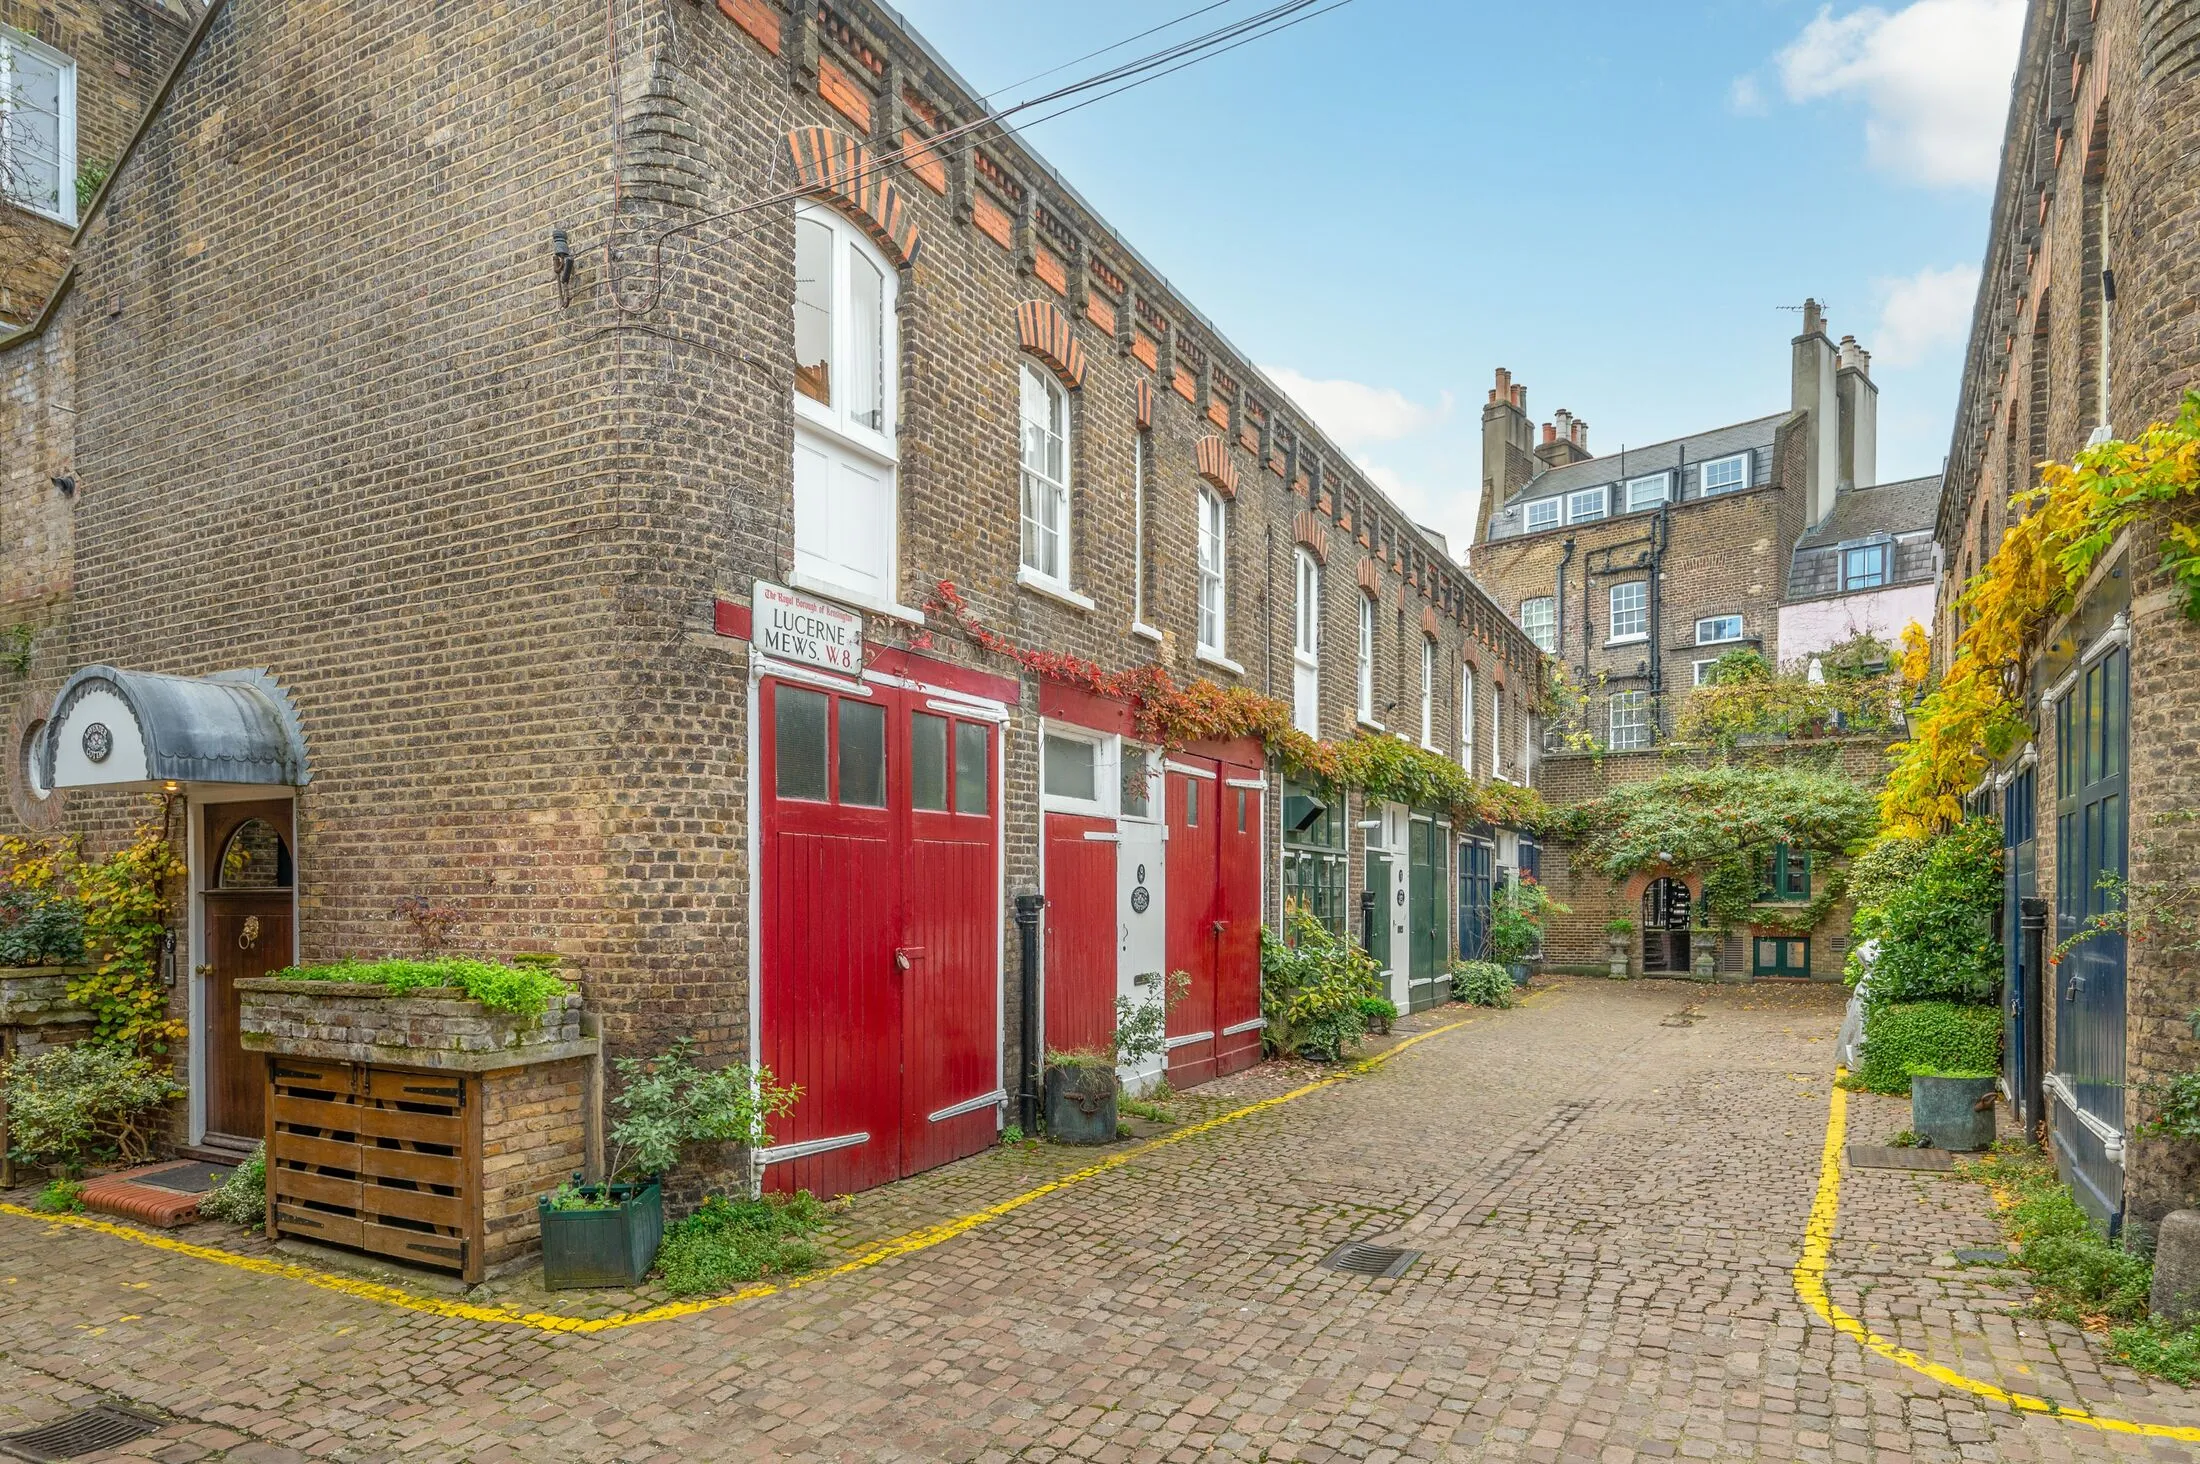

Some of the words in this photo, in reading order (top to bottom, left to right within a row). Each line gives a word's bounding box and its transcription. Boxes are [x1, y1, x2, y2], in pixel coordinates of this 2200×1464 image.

[765, 589, 776, 600] The
[778, 592, 794, 606] Royal
[796, 598, 817, 613] Borough
[819, 606, 825, 614] of
[774, 608, 845, 646] LUCERNE
[765, 628, 820, 660] MEWS.
